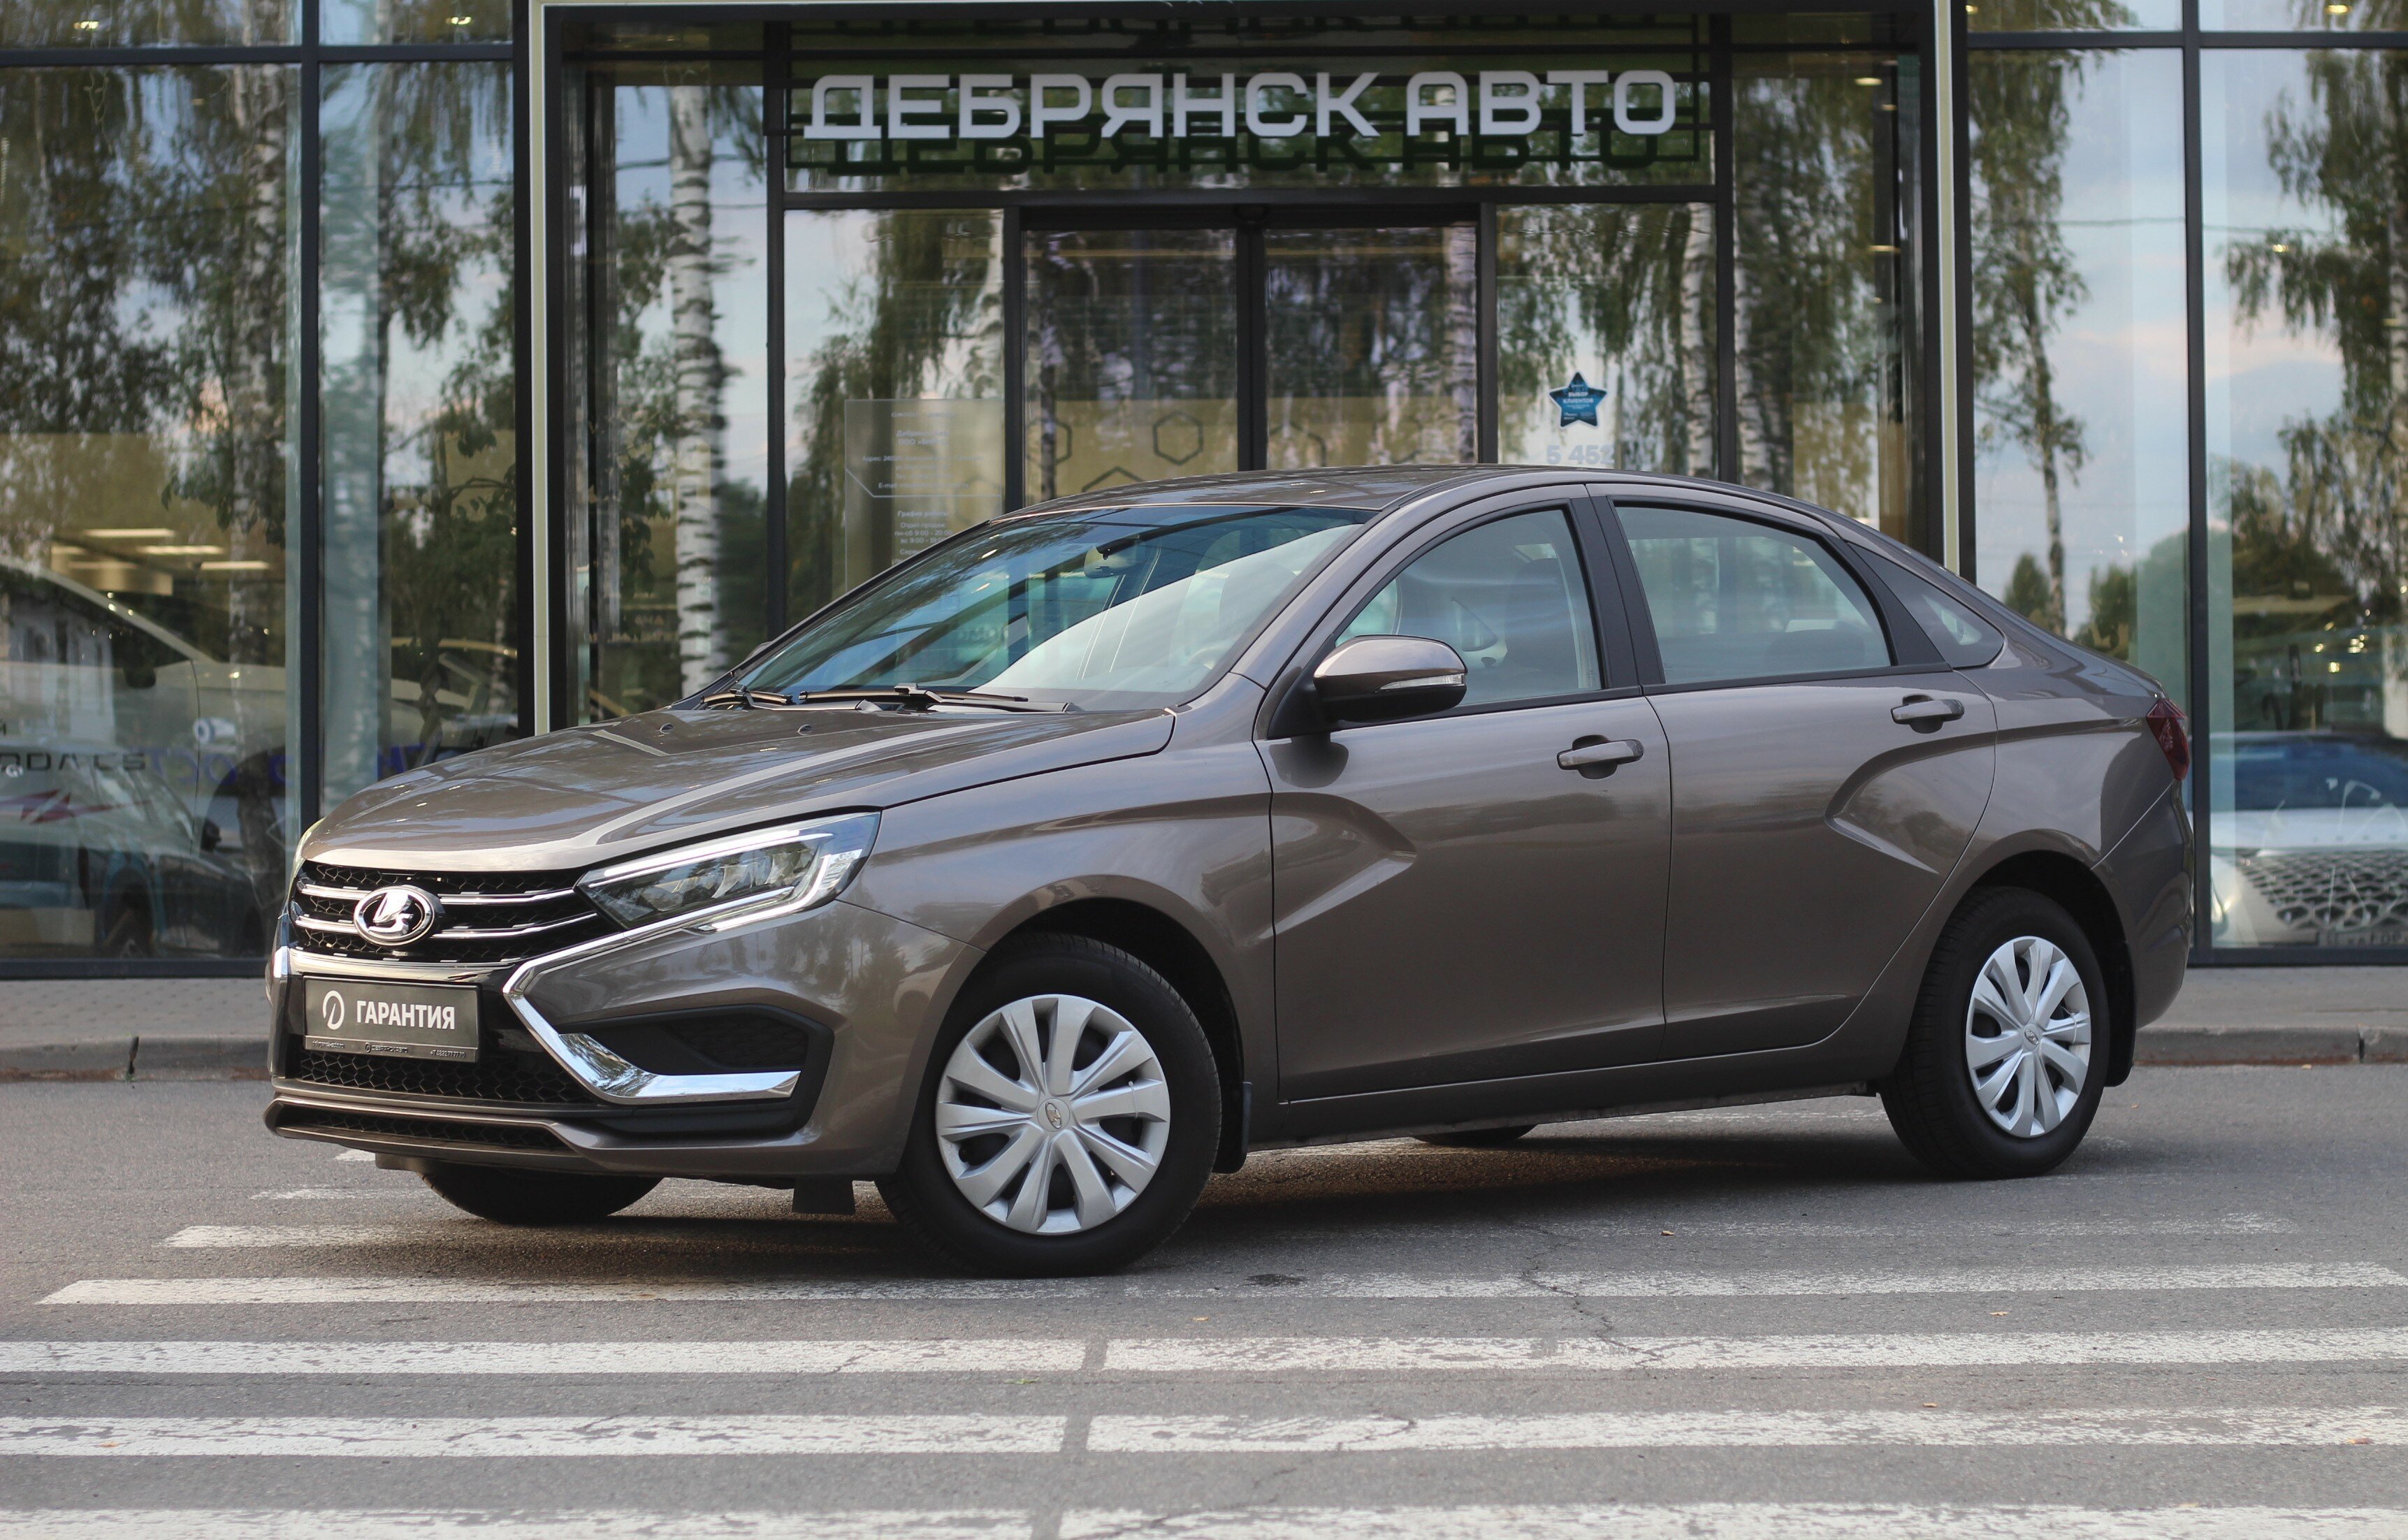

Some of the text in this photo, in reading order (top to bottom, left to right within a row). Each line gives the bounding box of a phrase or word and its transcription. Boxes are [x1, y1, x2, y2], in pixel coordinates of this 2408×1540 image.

[804, 70, 1676, 139] ДЕБРЯНСК АВТО
[356, 1000, 455, 1030] ГАРАНТИЯ
